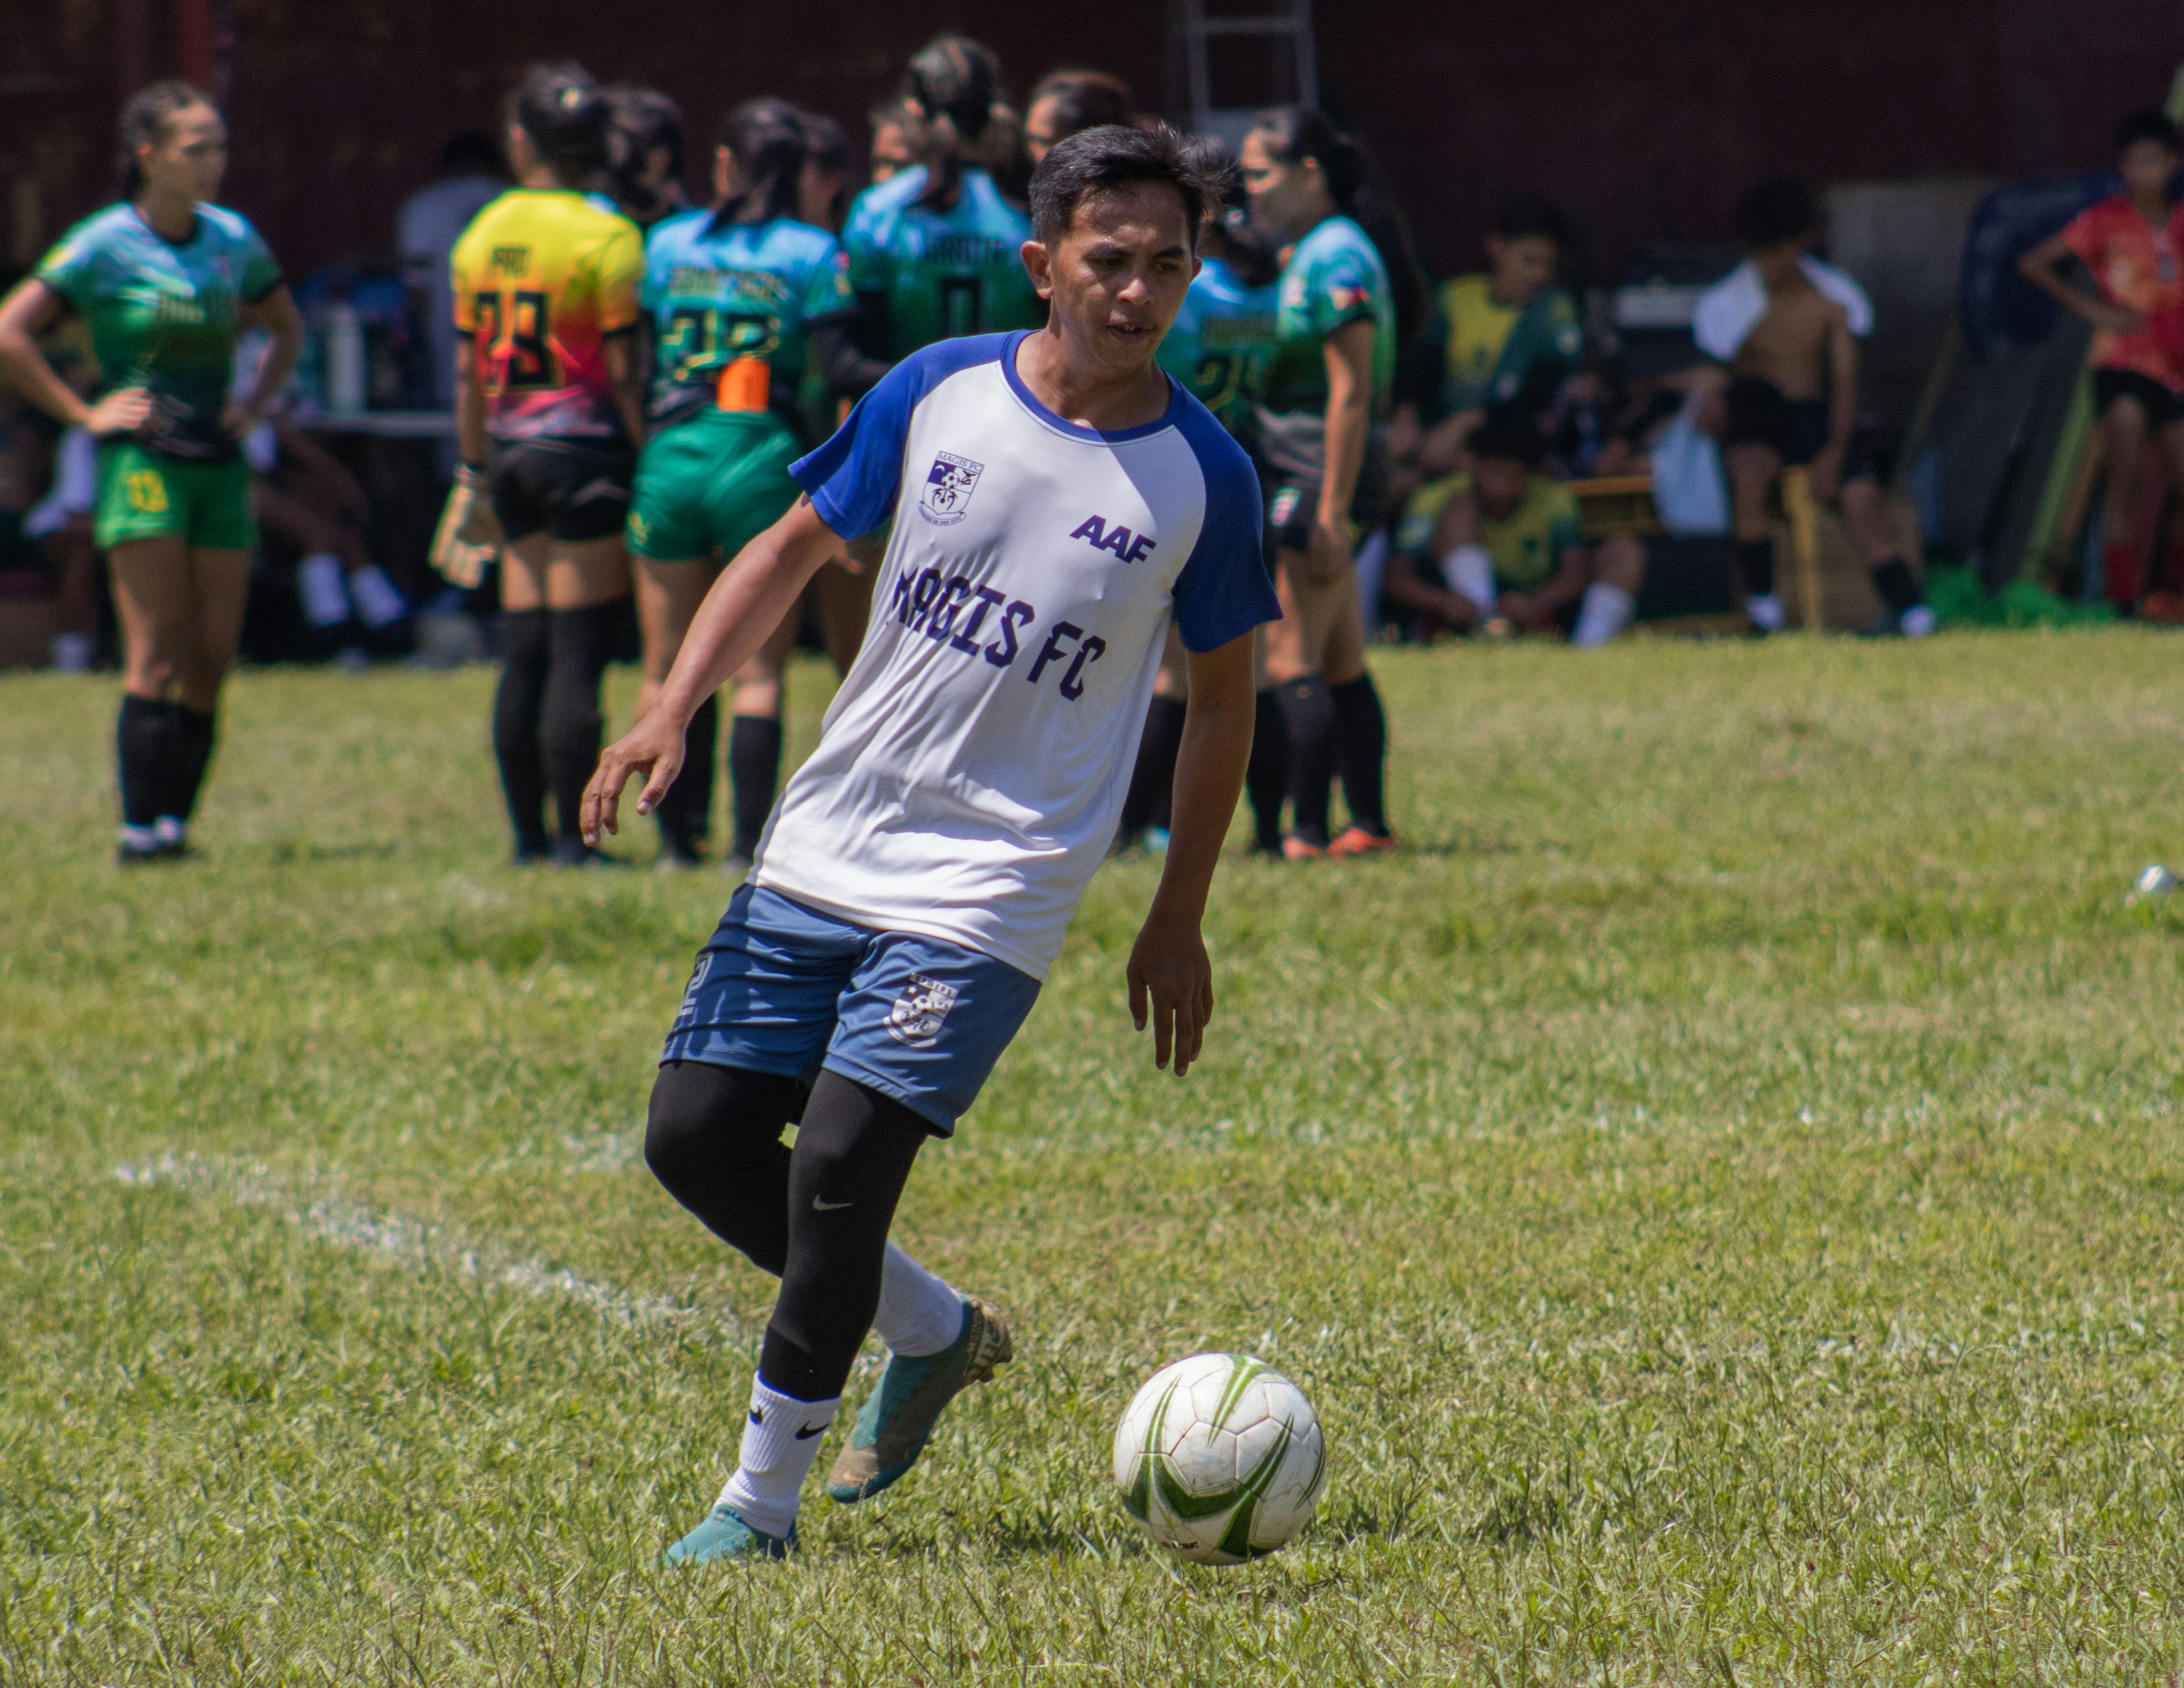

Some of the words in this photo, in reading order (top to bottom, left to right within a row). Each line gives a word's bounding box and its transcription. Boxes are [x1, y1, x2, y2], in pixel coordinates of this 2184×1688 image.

[937, 452, 968, 468] MAGIS
[968, 462, 983, 472] FC
[1069, 514, 1157, 564] AAF
[893, 566, 1035, 668] MAGIS
[1027, 620, 1106, 702] FC
